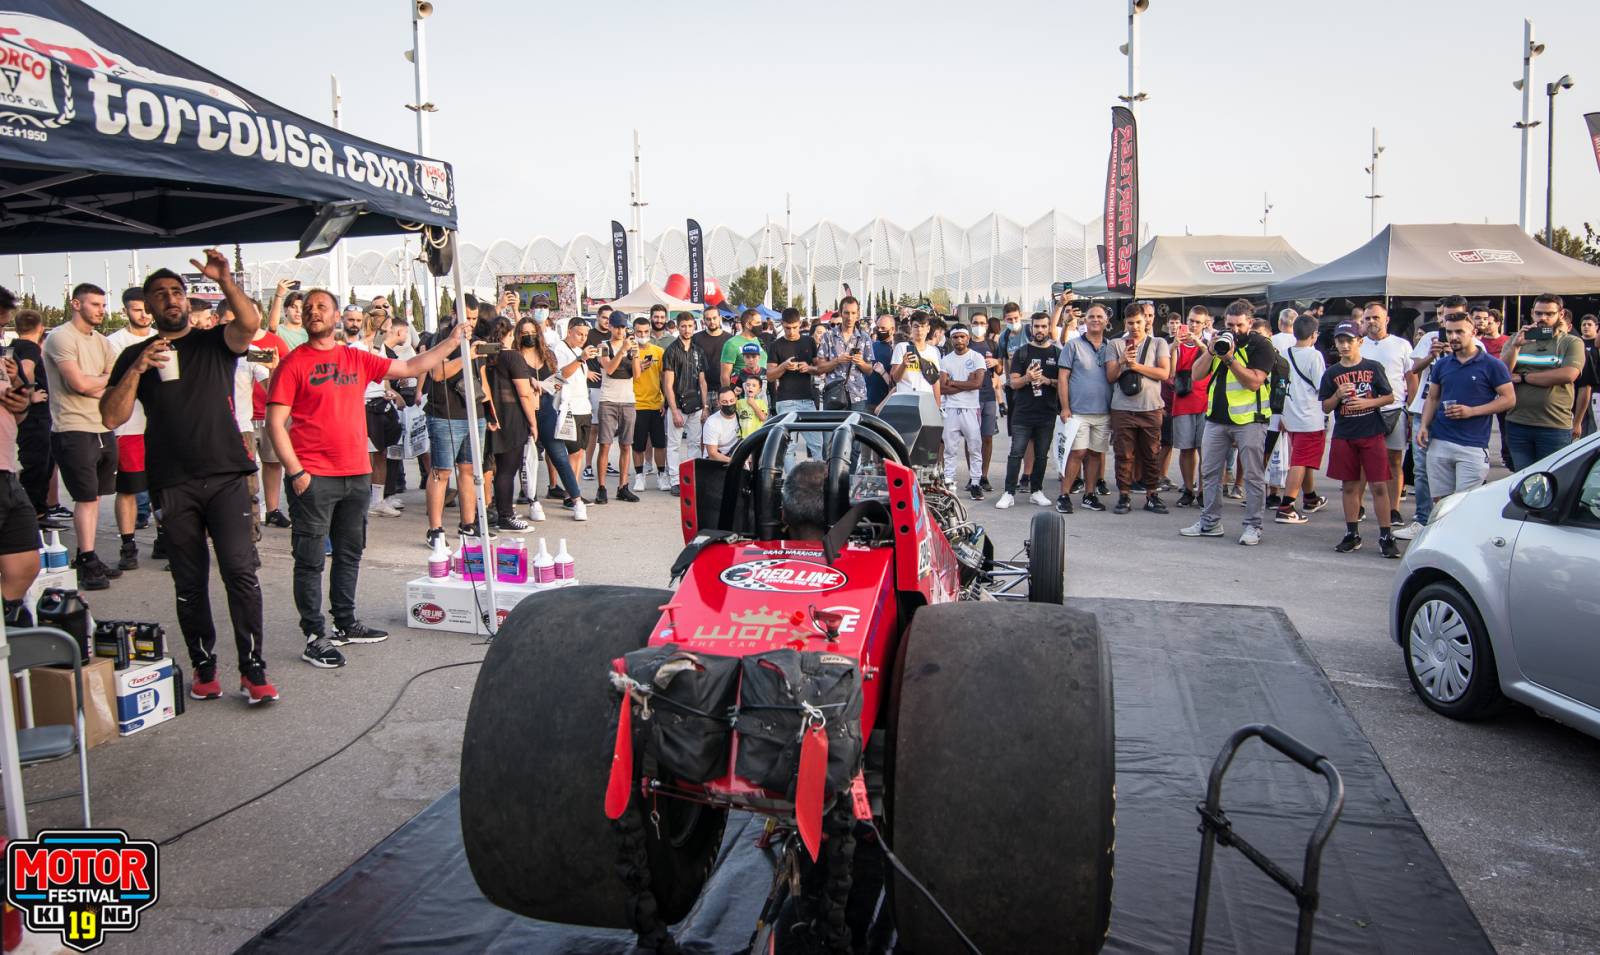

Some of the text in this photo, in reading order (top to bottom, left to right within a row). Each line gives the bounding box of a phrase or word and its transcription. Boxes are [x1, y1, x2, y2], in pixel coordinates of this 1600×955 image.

[0, 46, 46, 80] ORCO
[88, 71, 414, 197] torcousa.com
[756, 568, 795, 581] RED
